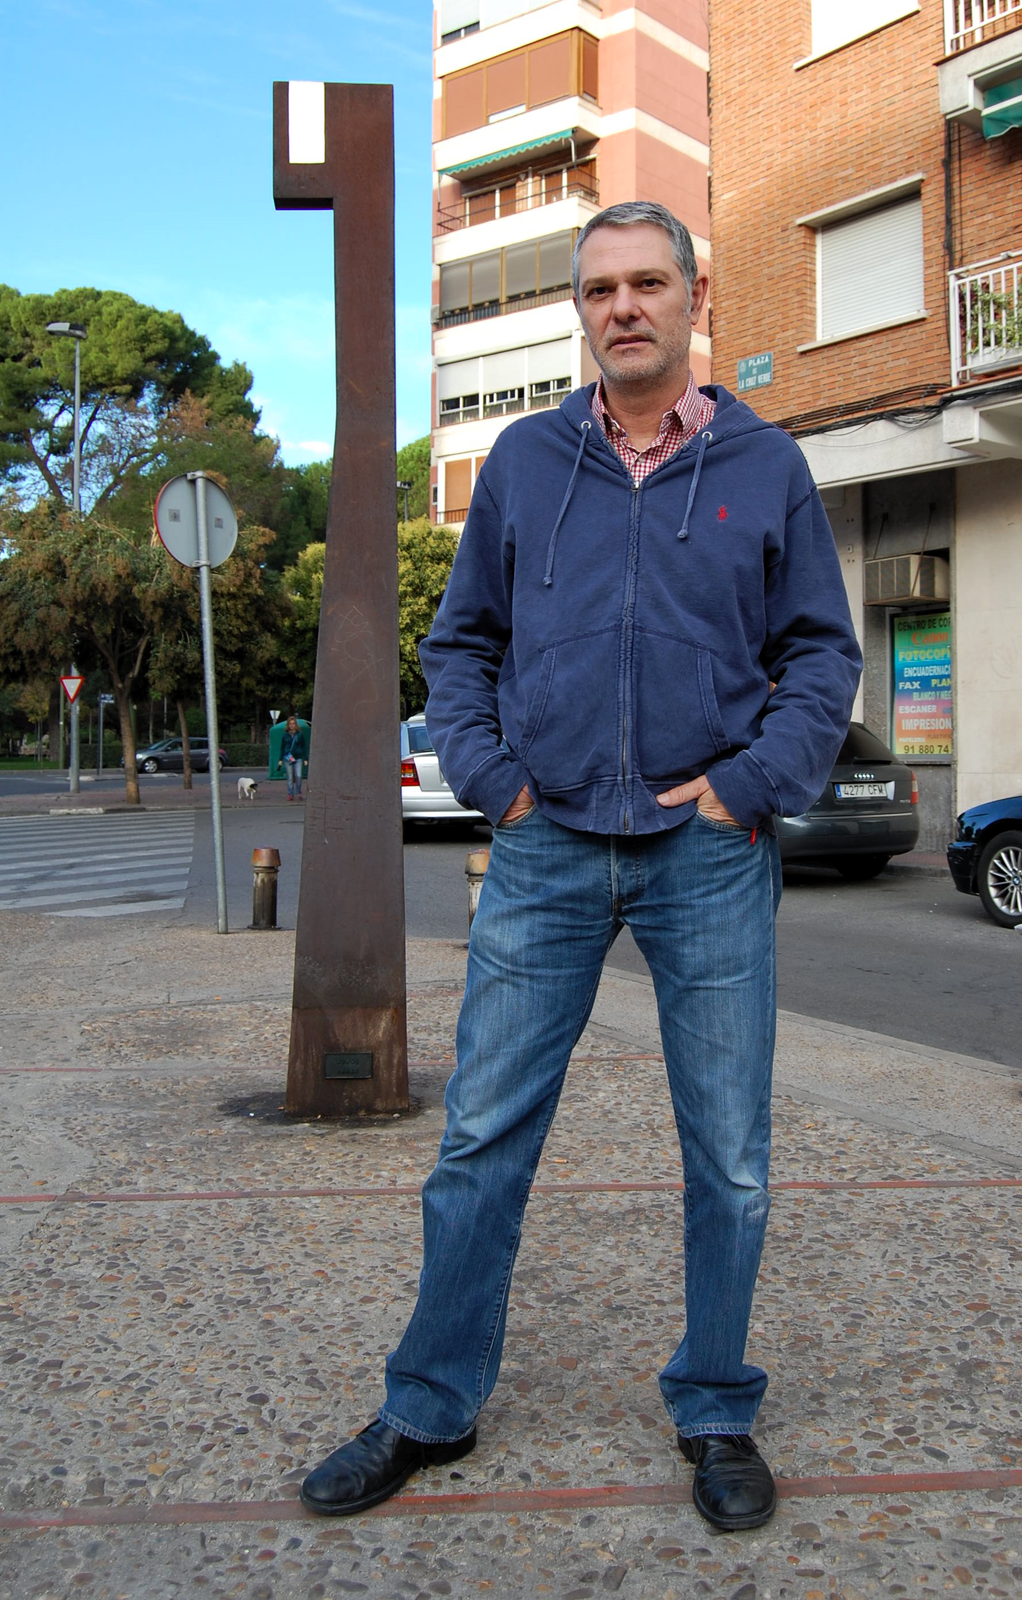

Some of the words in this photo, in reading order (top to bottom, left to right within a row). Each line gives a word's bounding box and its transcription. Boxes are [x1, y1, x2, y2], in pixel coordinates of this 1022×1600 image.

[748, 355, 769, 367] PLAZA
[739, 380, 744, 389] LA
[746, 376, 756, 387] CRUZ
[758, 372, 771, 383] VERDE
[898, 619, 926, 632] CENTRO
[928, 618, 937, 629] DE
[912, 632, 948, 645] Canon
[899, 682, 921, 690] FAX
[913, 690, 935, 701] BLANCO
[899, 705, 937, 714] ESCANER
[902, 717, 952, 731] IMPRESION
[904, 744, 915, 754] 91
[918, 744, 935, 754] 880
[938, 744, 949, 754] 74
[843, 785, 864, 796] 4277
